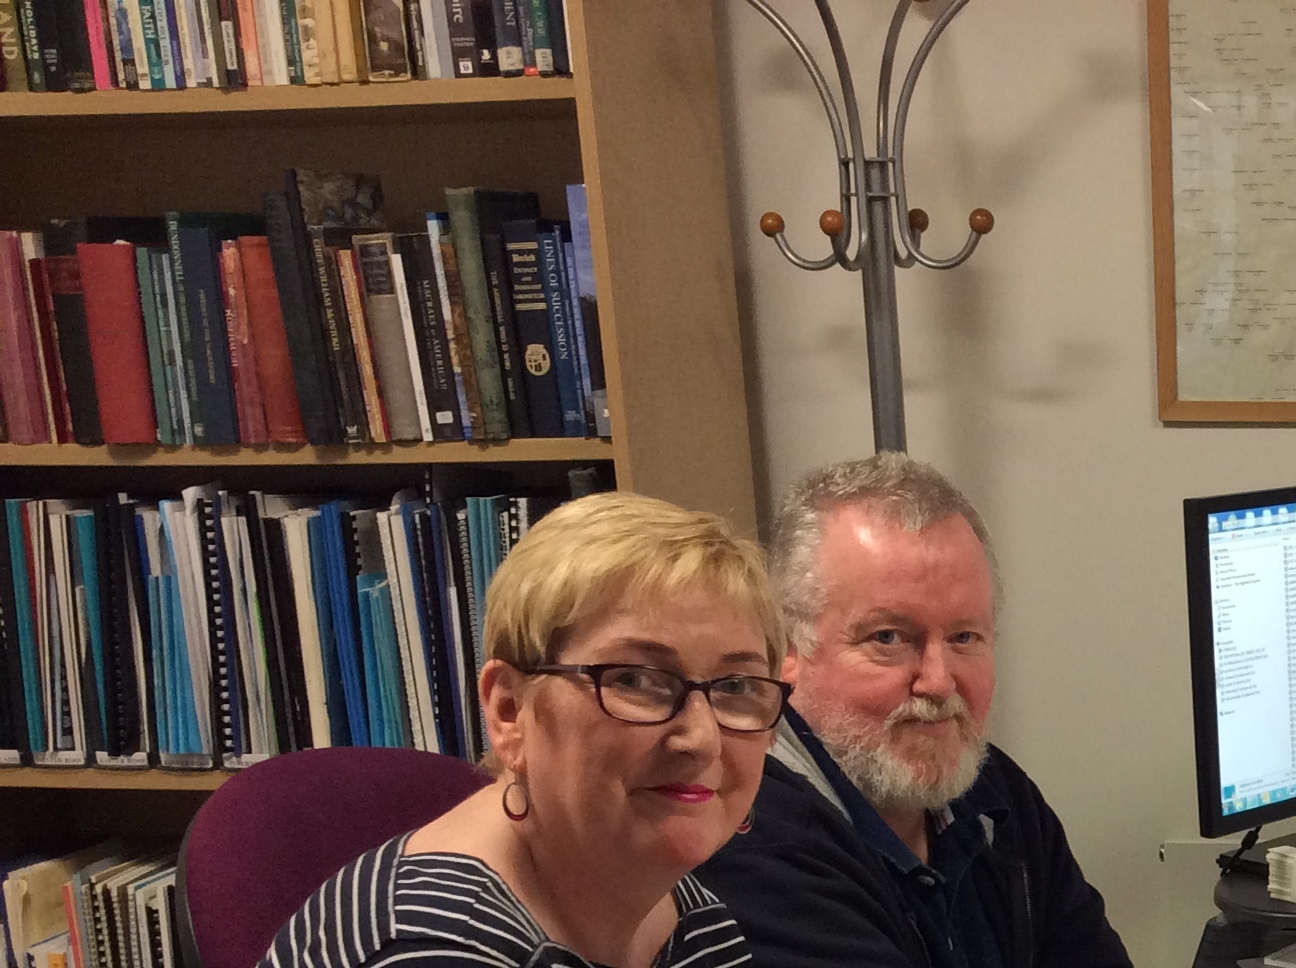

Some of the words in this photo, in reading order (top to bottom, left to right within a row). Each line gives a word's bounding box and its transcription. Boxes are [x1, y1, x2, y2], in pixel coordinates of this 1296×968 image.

[24, 1, 39, 59] HOLIDAYS
[141, 6, 156, 39] FAITH
[168, 220, 184, 282] DUNDONNELL
[313, 238, 323, 265] CHIEF
[318, 267, 332, 307] WILLIAM
[543, 239, 556, 271] LINES
[548, 273, 560, 288] OF
[551, 291, 568, 360] SUCCESSION
